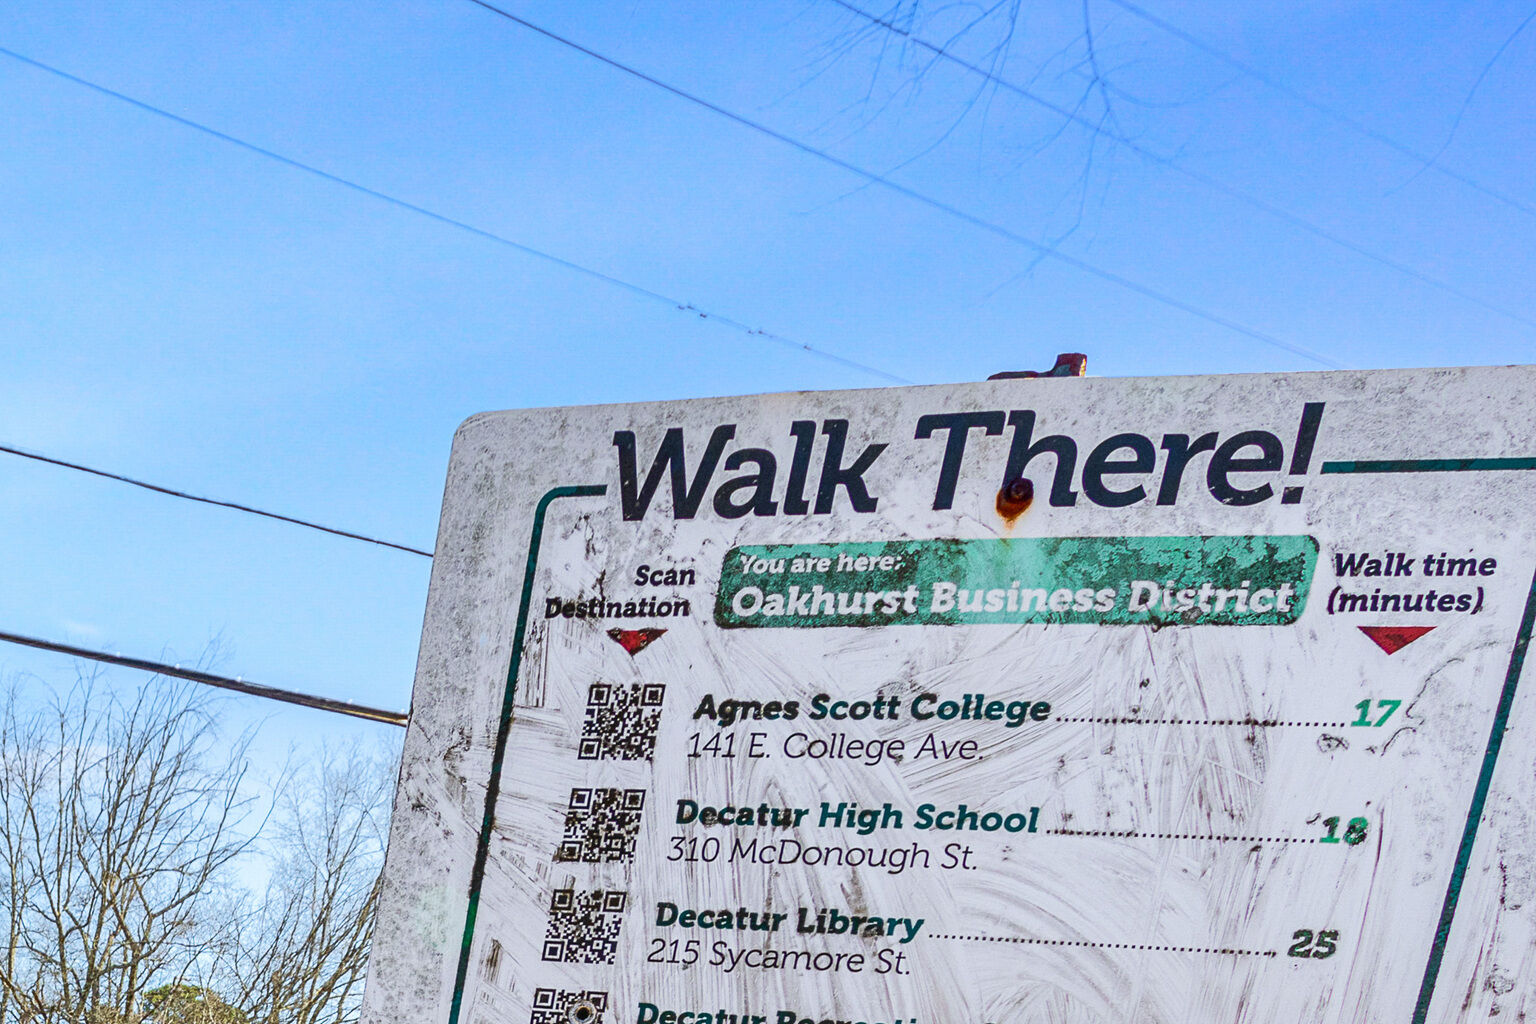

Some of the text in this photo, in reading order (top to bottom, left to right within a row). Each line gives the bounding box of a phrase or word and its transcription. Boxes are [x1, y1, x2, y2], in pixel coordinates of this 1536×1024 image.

[613, 401, 1326, 522] Walk There!
[634, 564, 695, 587] Scan
[739, 552, 903, 574] You are here:
[1335, 552, 1496, 578] Walk time
[544, 597, 690, 619] Destination
[731, 580, 1295, 618] Oakhurst Business District
[1326, 585, 1485, 615] (minutes)
[692, 693, 1402, 728] Agnes Scott College 17
[687, 732, 985, 766] 141 E. College Ave.
[675, 800, 809, 828] Decatur
[819, 802, 903, 836] High
[913, 803, 1040, 833] School
[666, 836, 978, 874] 310 McDonough St.
[655, 902, 1339, 959] Decatur Library 25
[647, 939, 911, 976] 215 Sycamore St.
